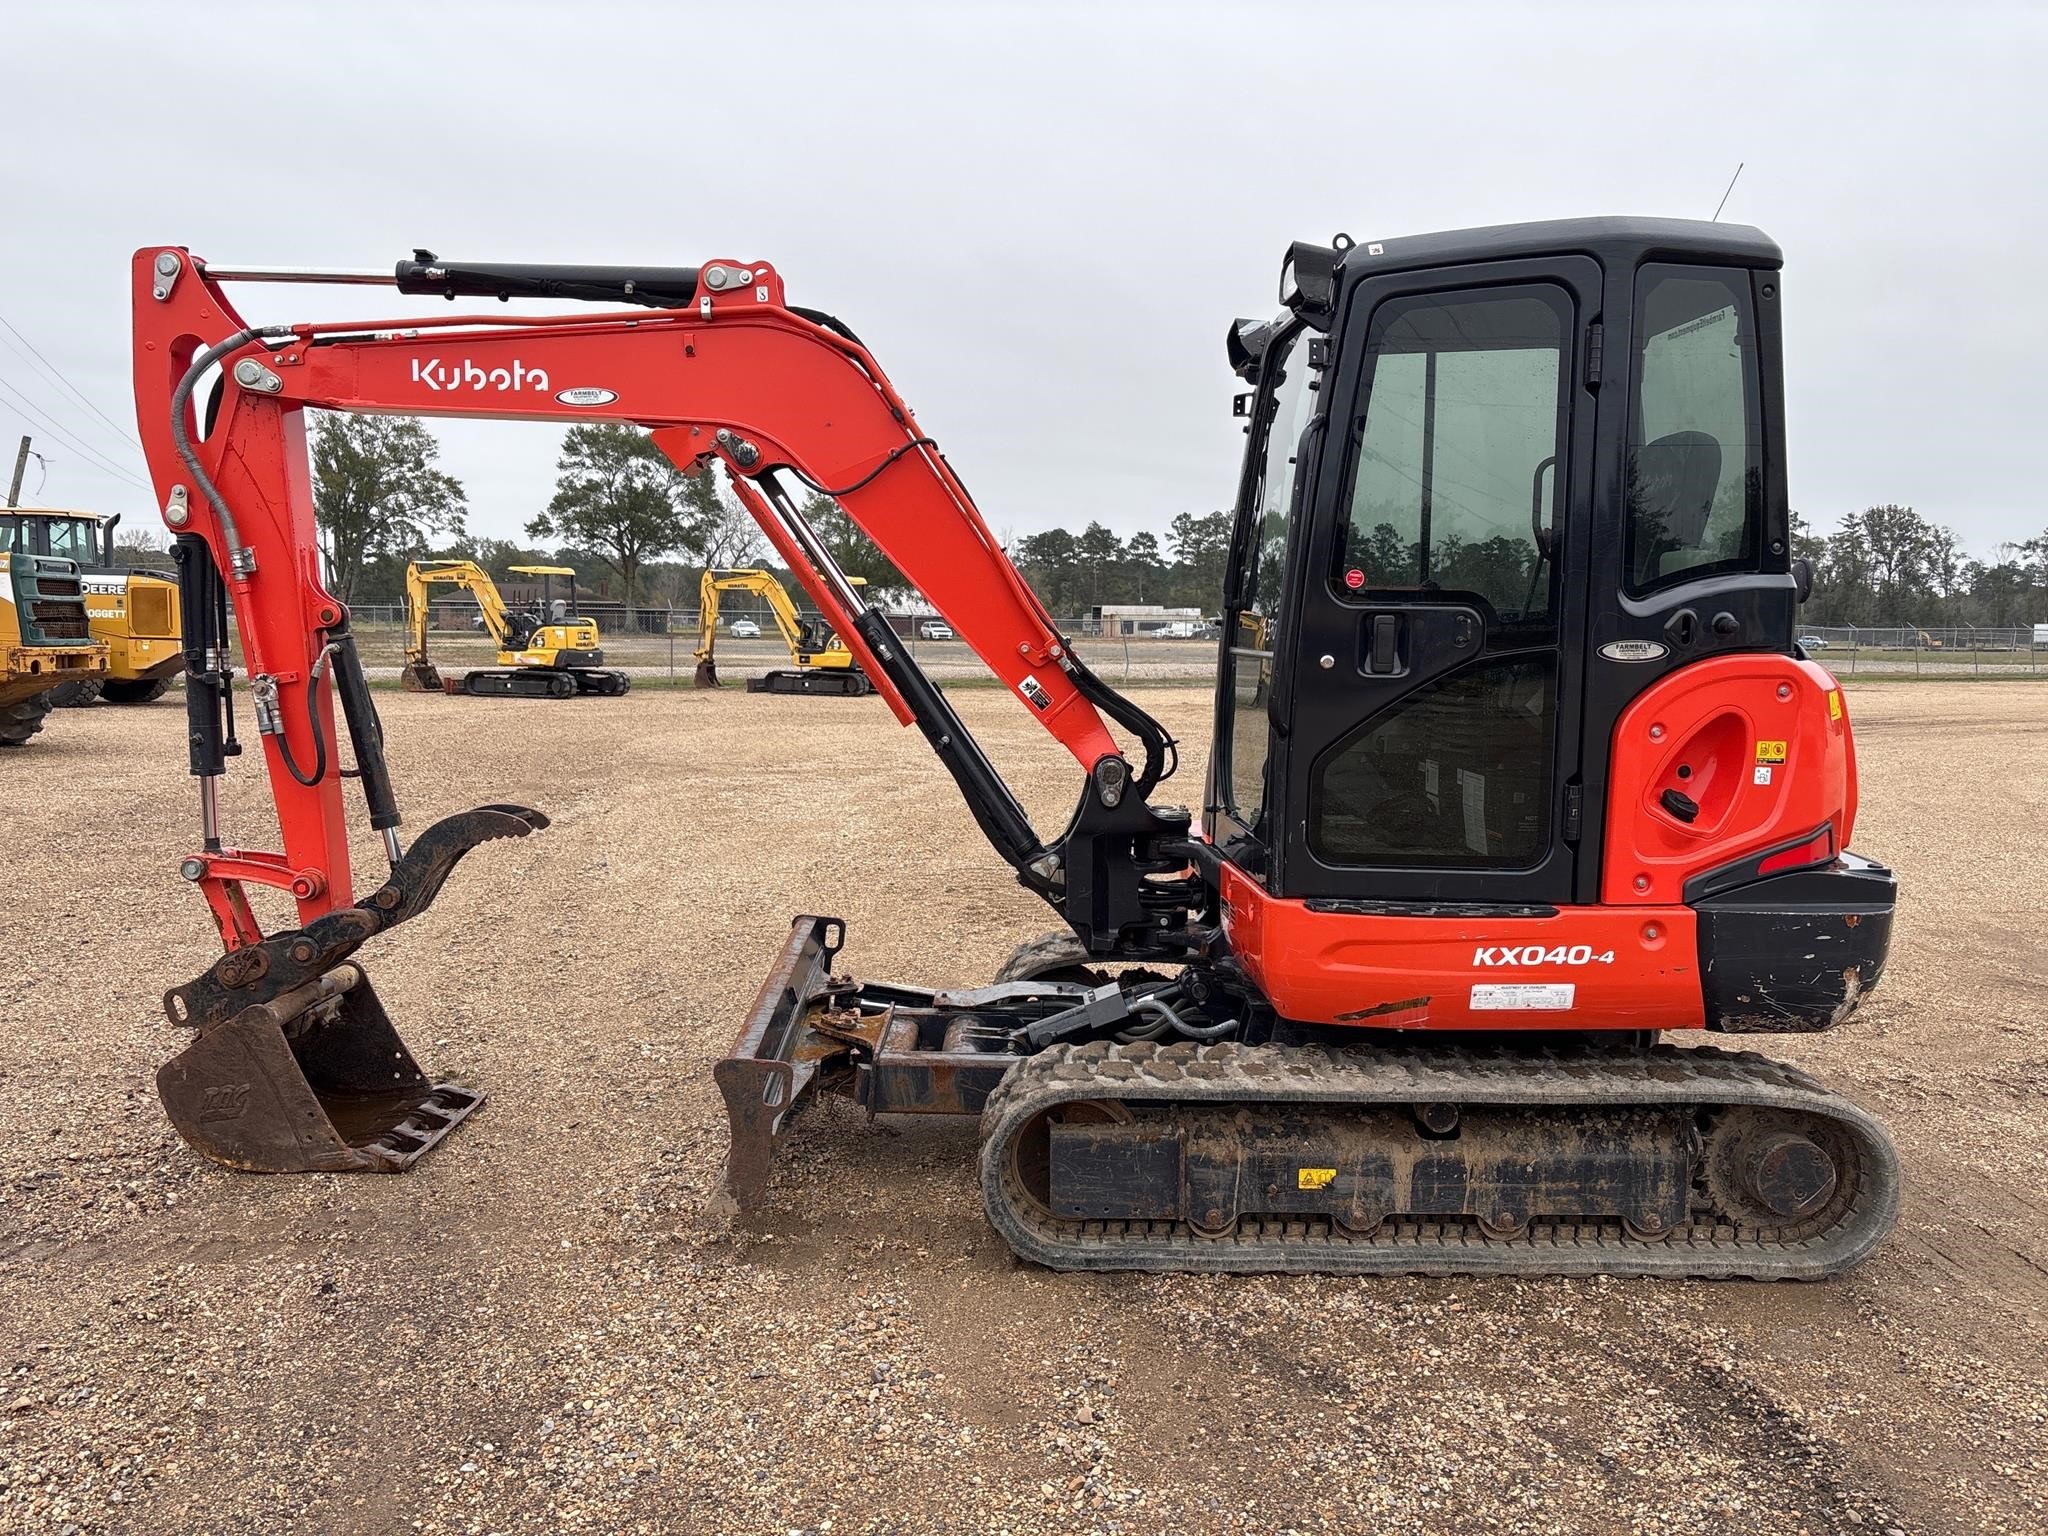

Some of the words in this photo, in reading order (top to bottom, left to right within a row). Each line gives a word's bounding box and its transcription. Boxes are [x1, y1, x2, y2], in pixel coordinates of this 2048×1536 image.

[411, 358, 549, 391] Kubota
[81, 582, 126, 595] DEERE
[88, 609, 126, 619] OGGETT
[1472, 945, 1615, 967] KX040-4
